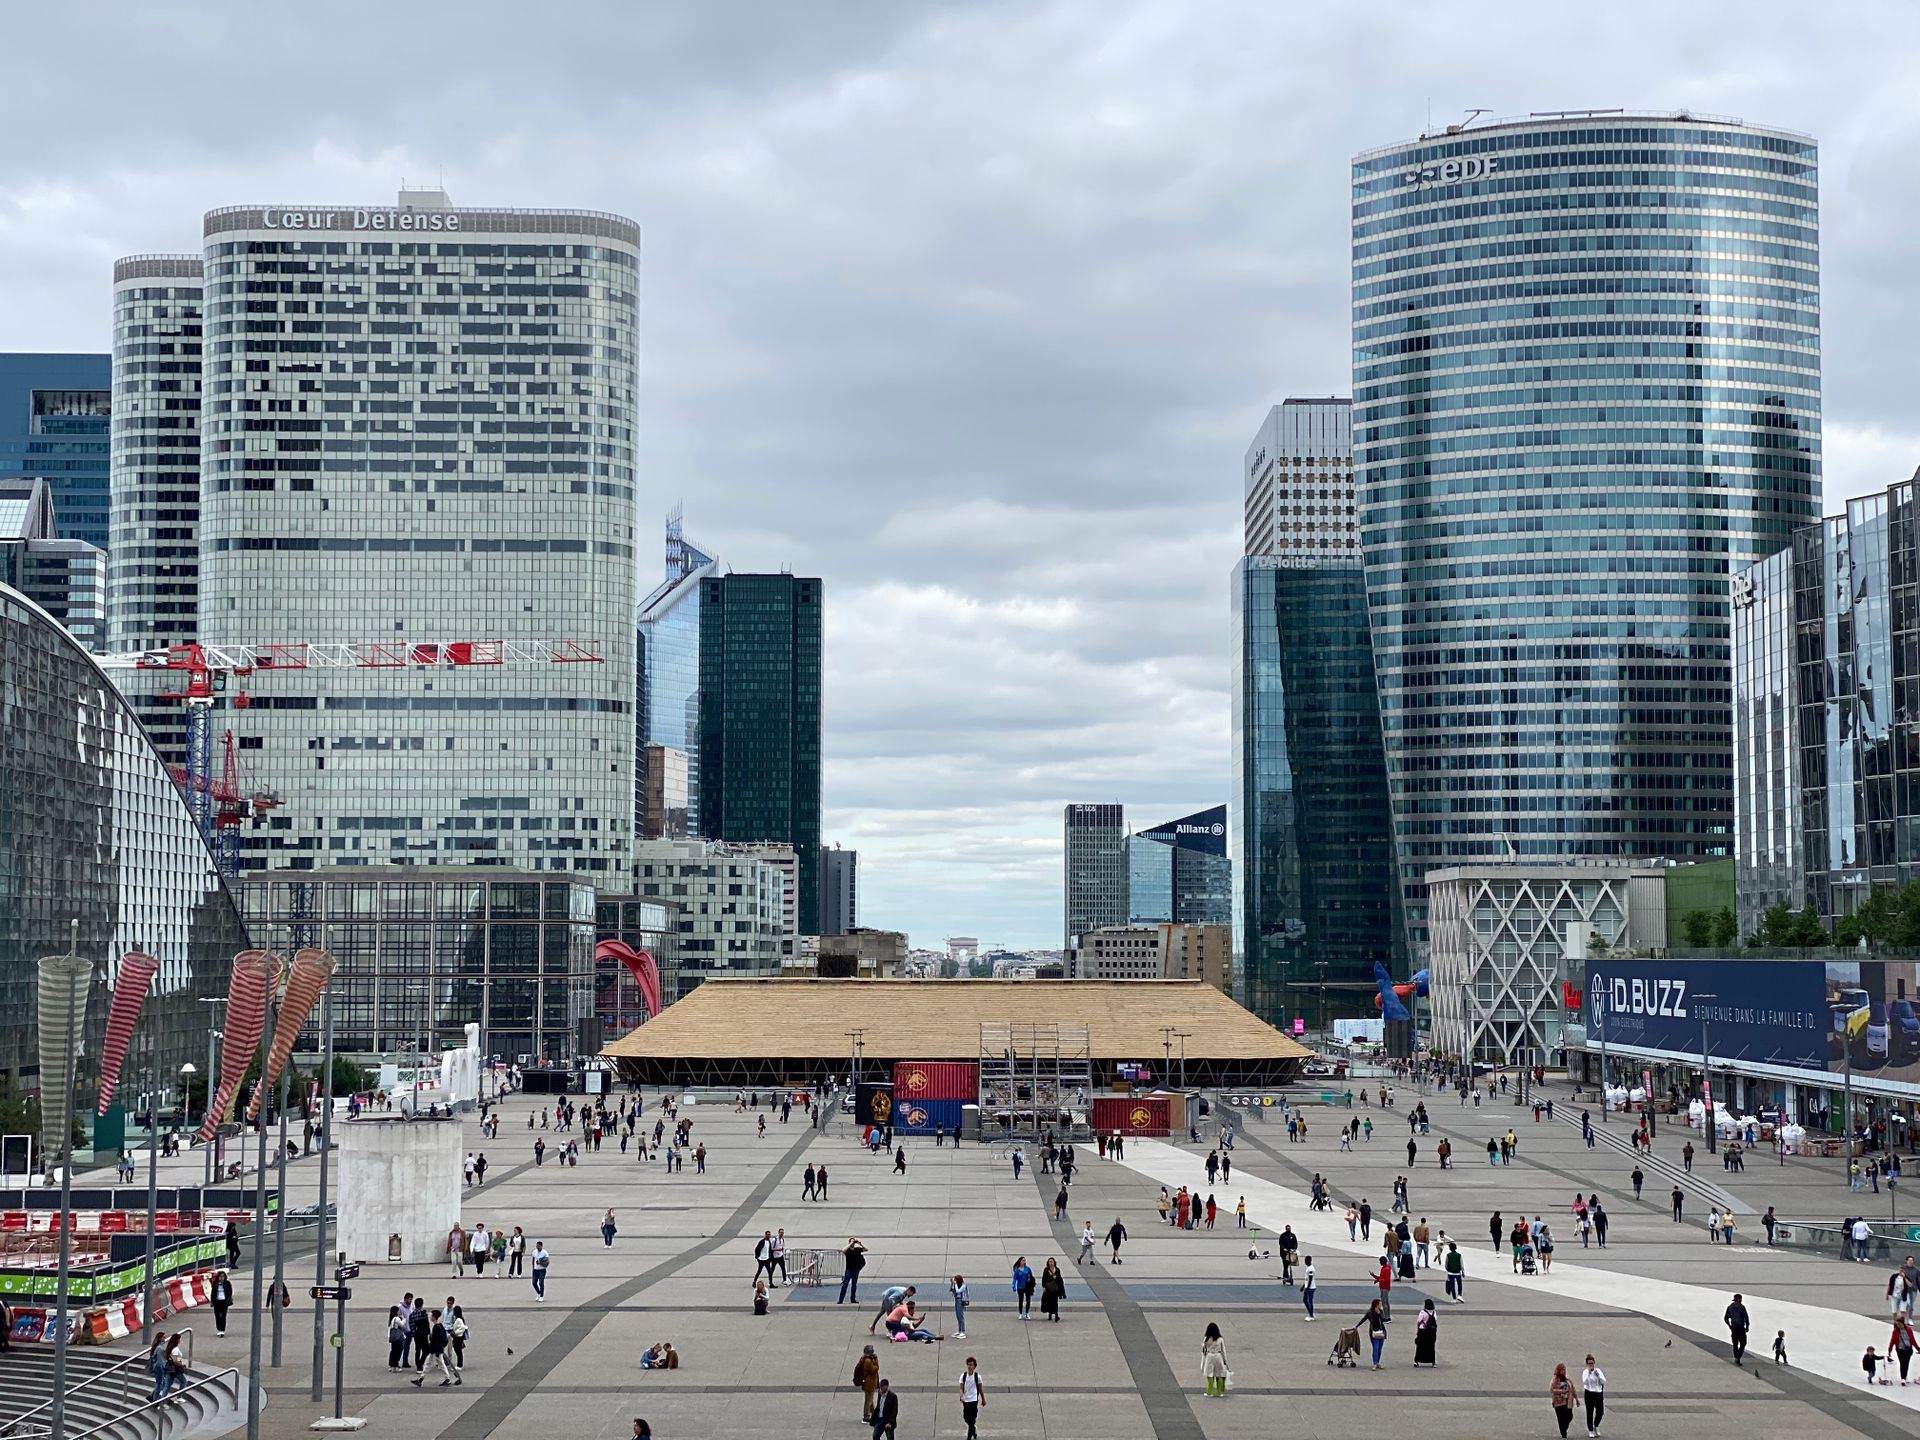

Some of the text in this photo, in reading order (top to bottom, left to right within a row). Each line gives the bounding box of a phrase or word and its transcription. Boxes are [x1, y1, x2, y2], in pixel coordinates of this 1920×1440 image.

[263, 207, 335, 229] Cœur
[1176, 824, 1210, 834] Allianz
[1694, 1005, 1733, 1022] BIENVENUE
[1735, 1008, 1754, 1024] DANS
[1756, 1009, 1767, 1025] LA
[1768, 1010, 1802, 1028] FAMILLE
